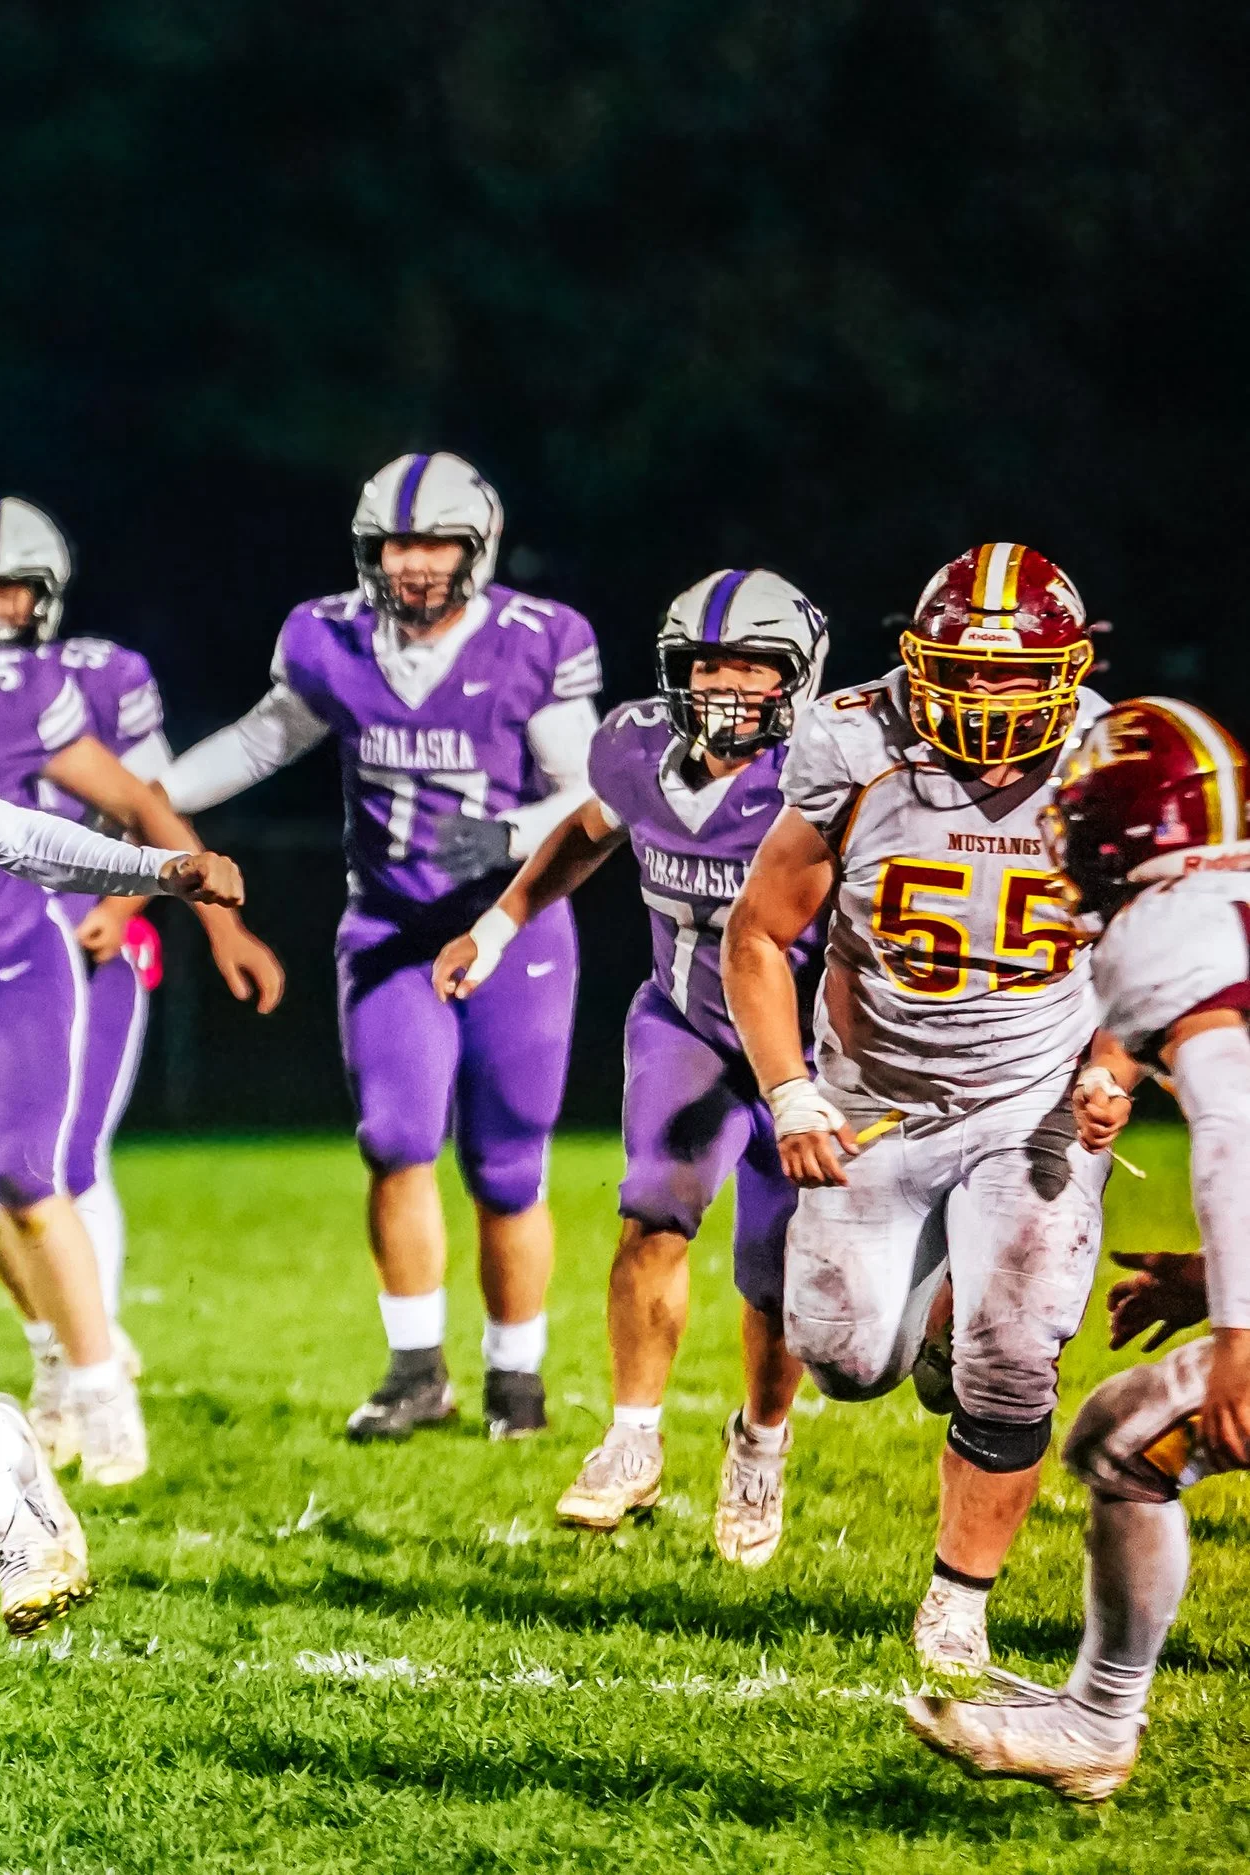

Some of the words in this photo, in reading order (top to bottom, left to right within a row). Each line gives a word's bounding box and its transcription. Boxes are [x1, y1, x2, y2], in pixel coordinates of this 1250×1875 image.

[947, 833, 1043, 856] MUSTANGS
[640, 885, 732, 1015] 7
[871, 856, 1075, 998] 55
